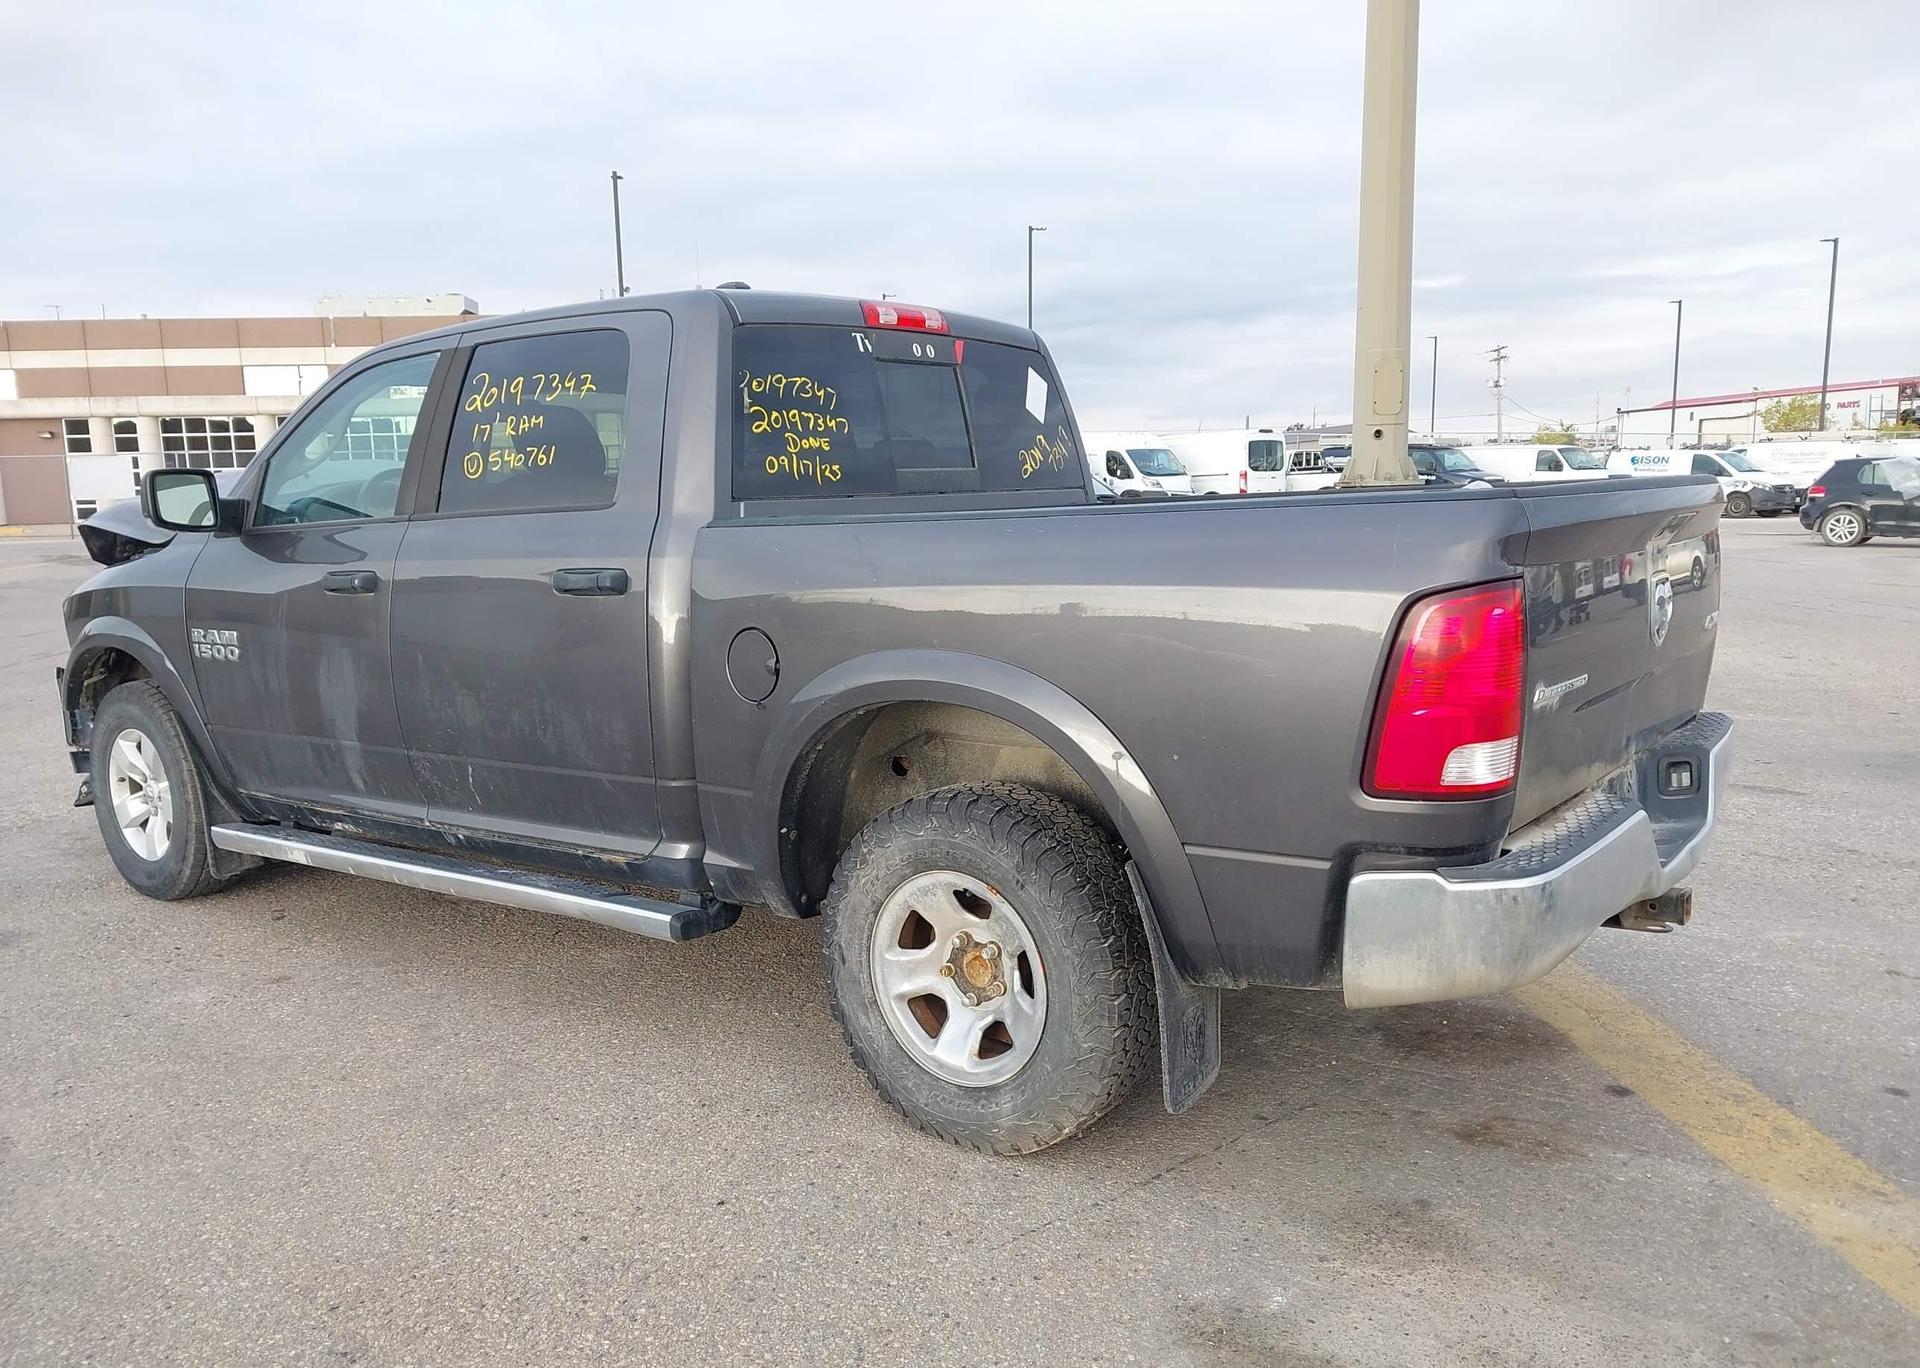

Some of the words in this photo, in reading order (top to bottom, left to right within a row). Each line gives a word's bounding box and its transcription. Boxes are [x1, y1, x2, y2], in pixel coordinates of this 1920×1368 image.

[1836, 400, 1860, 409] PARTS
[505, 415, 544, 436] RAM
[749, 406, 849, 434] 20197347
[488, 445, 556, 471] 540761
[1018, 434, 1051, 479] 2019
[765, 453, 842, 485] 09/17/25
[191, 628, 238, 645] RAM
[192, 643, 240, 662] 1500
